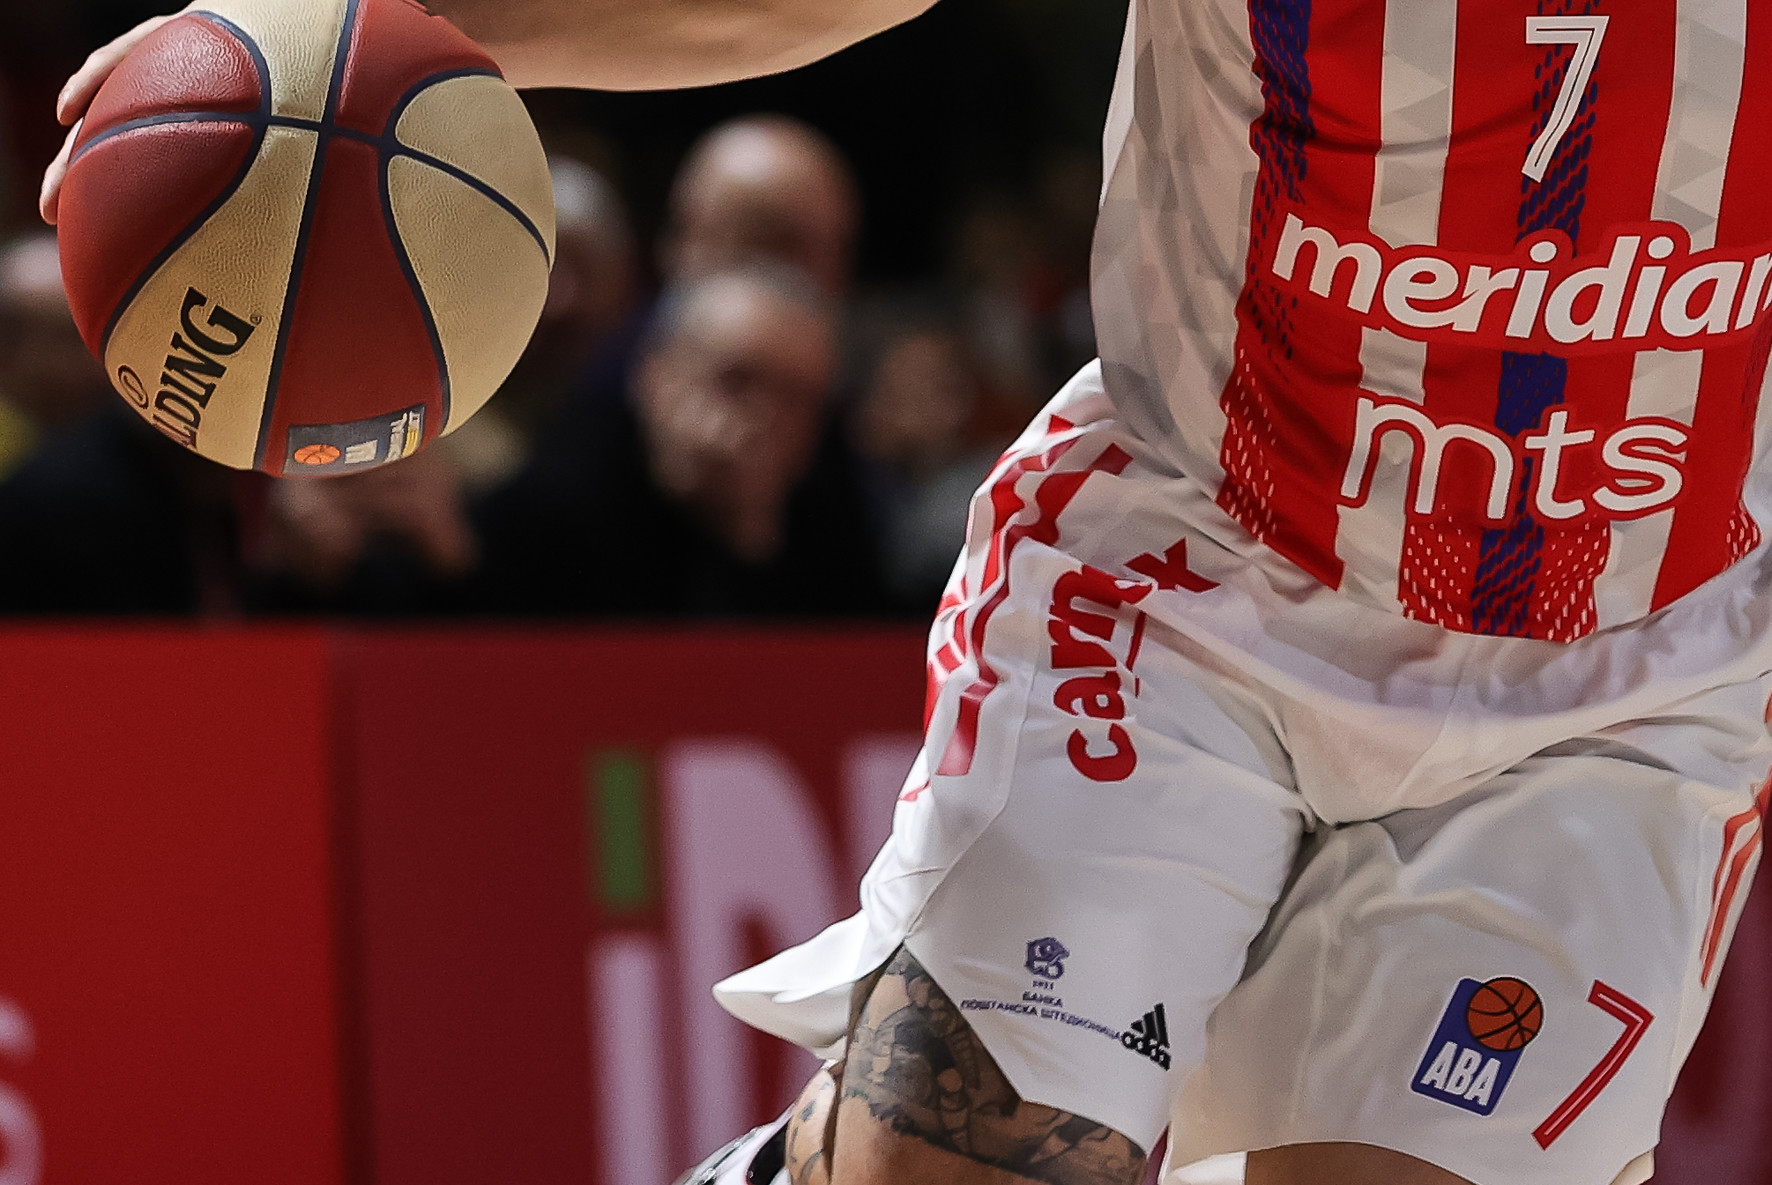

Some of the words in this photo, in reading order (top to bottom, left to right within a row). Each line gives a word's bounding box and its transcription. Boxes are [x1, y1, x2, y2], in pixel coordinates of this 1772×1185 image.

[1521, 15, 1610, 183] 7
[152, 286, 256, 450] LDING
[1339, 396, 1689, 520] mts
[1420, 1041, 1502, 1107] ABA
[1531, 979, 1656, 1151] 7
